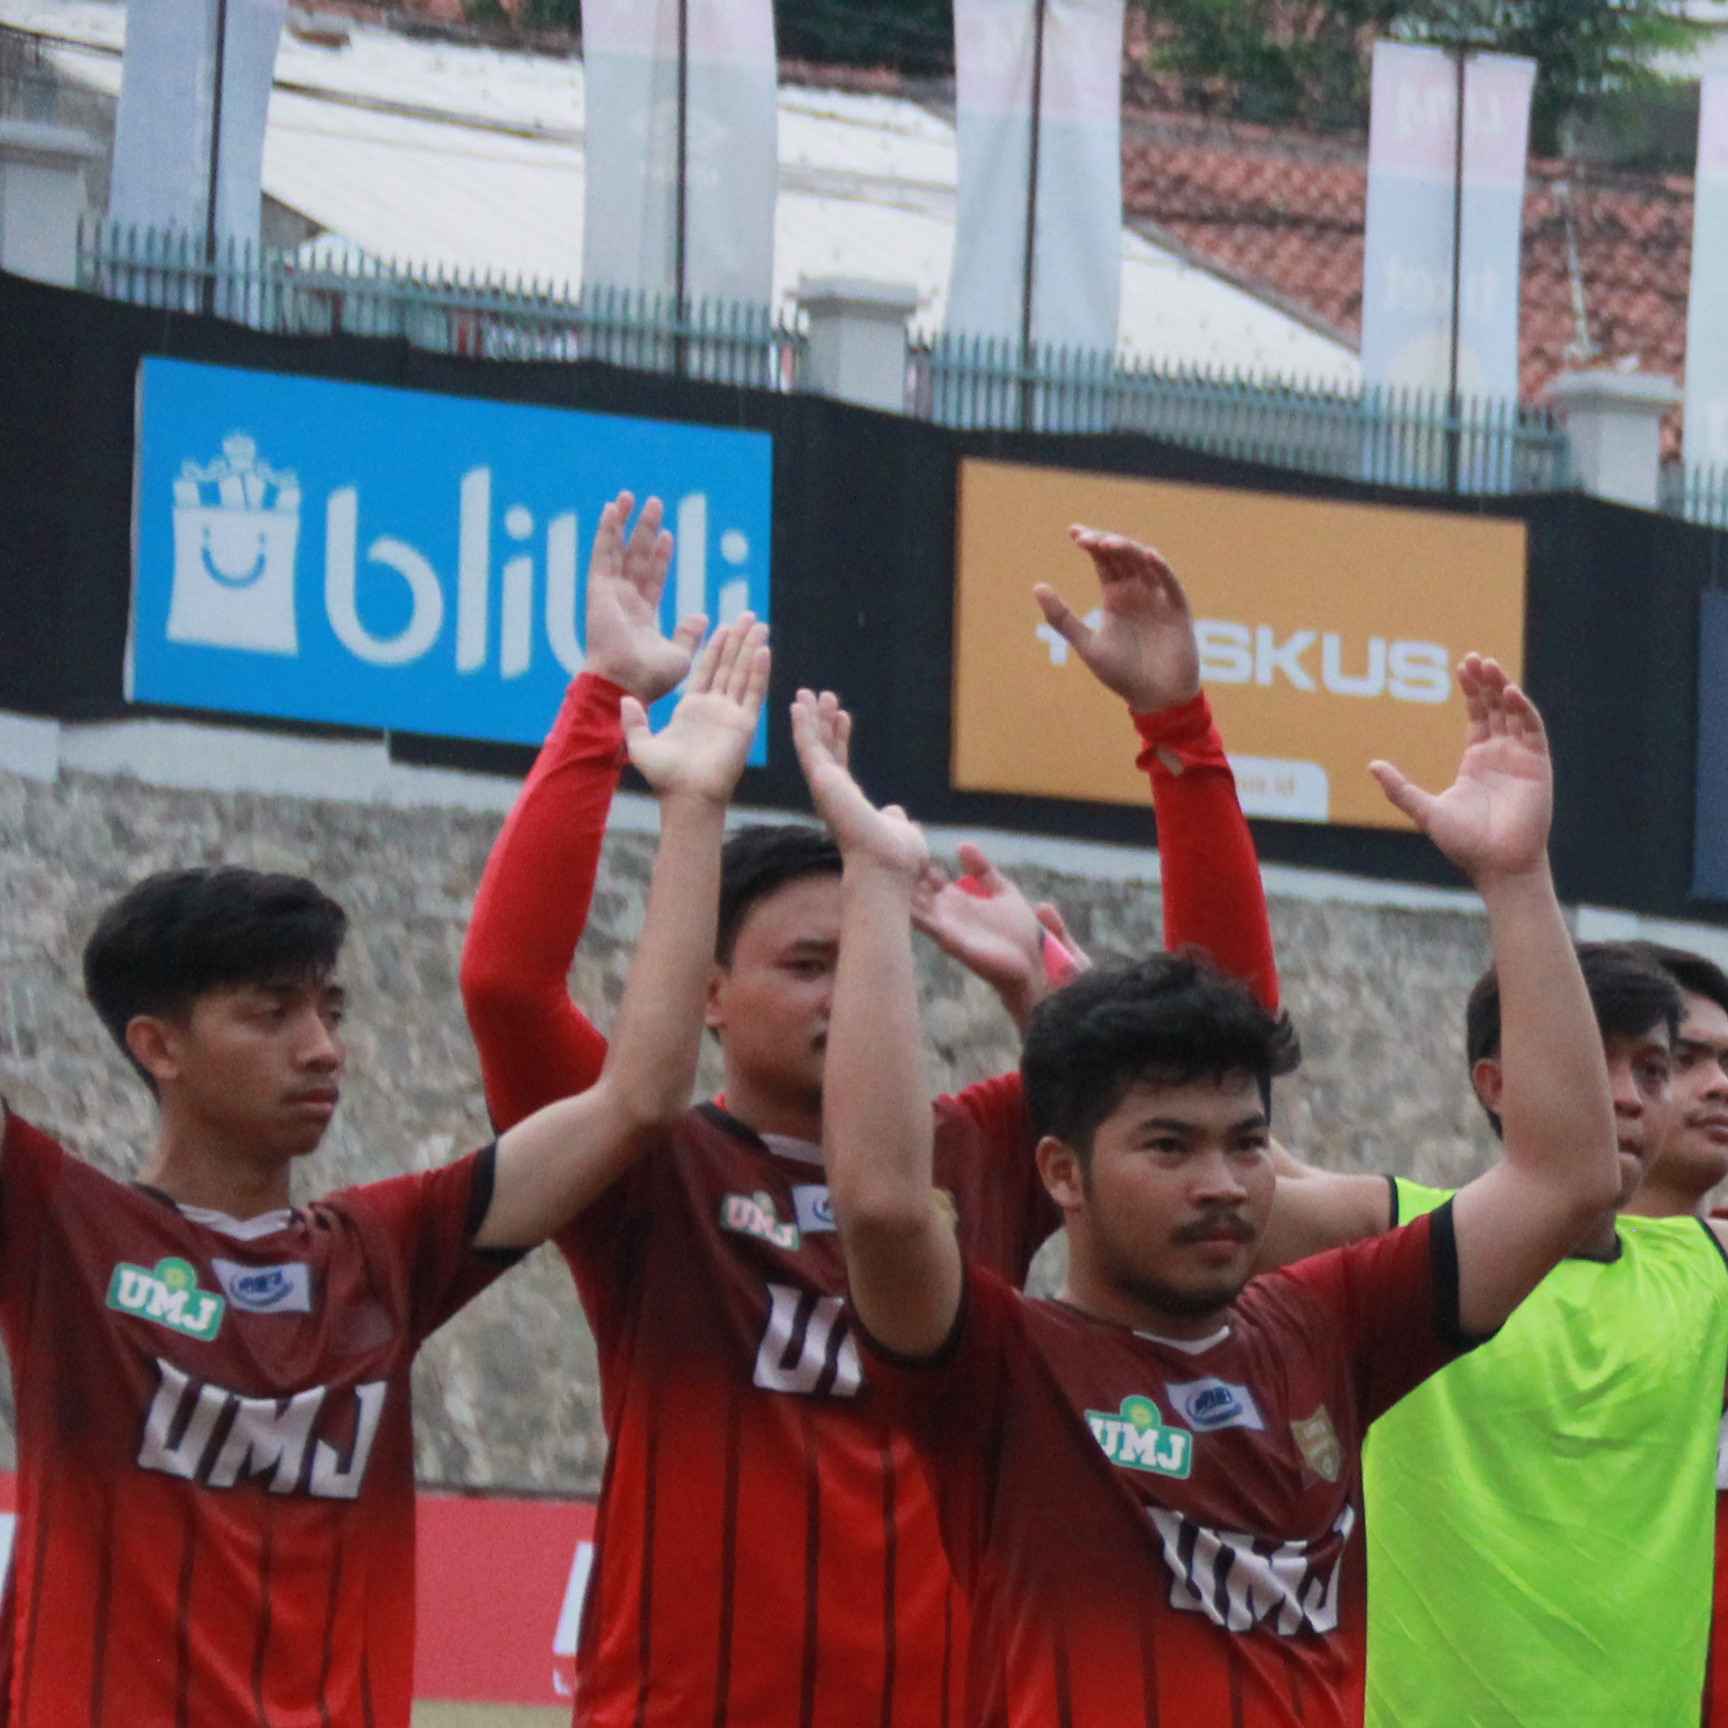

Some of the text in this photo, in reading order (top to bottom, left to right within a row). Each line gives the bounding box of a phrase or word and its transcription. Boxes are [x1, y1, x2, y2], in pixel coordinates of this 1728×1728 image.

[1035, 606, 1452, 705] SKUS
[117, 1269, 218, 1332] UMJ
[137, 1358, 387, 1500] UMJ
[1146, 1503, 1356, 1636] UMJ
